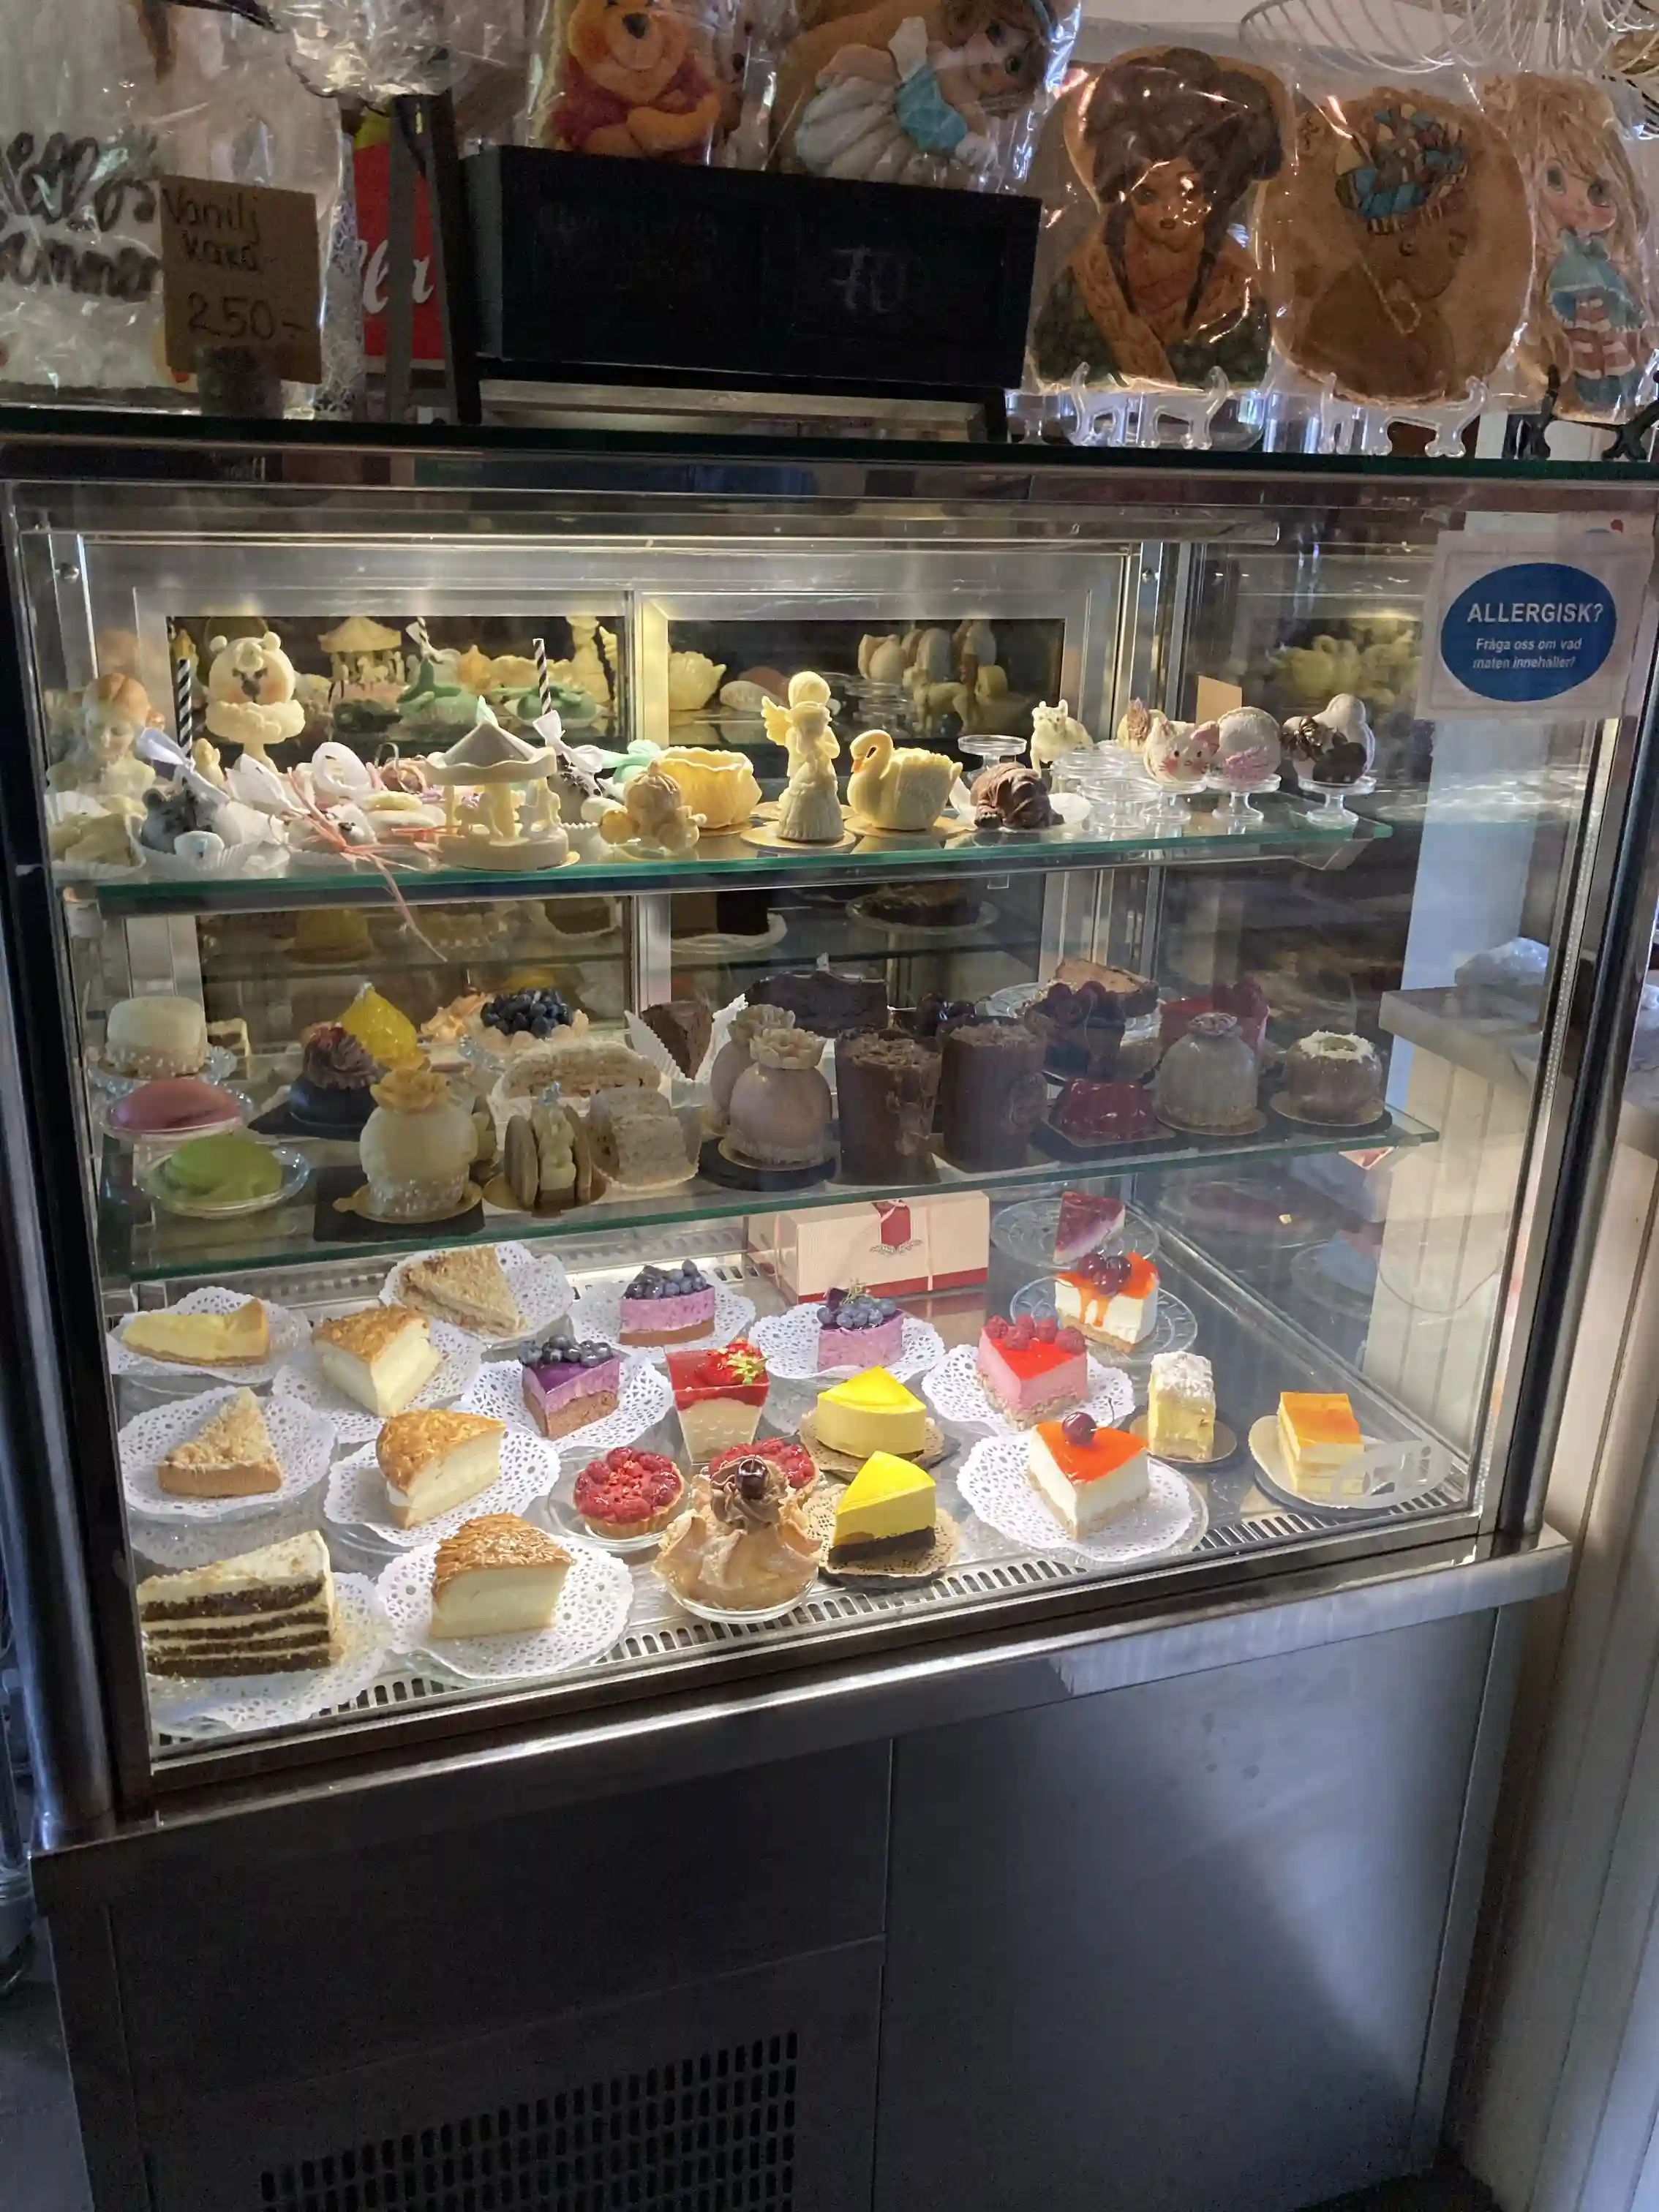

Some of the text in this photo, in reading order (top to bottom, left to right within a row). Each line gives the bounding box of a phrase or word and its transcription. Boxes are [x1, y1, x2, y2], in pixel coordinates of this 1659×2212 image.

[1467, 602, 1604, 623] ALLERGISK?
[1475, 637, 1583, 653] Fråga oss om vad
[1472, 656, 1510, 669] maten
